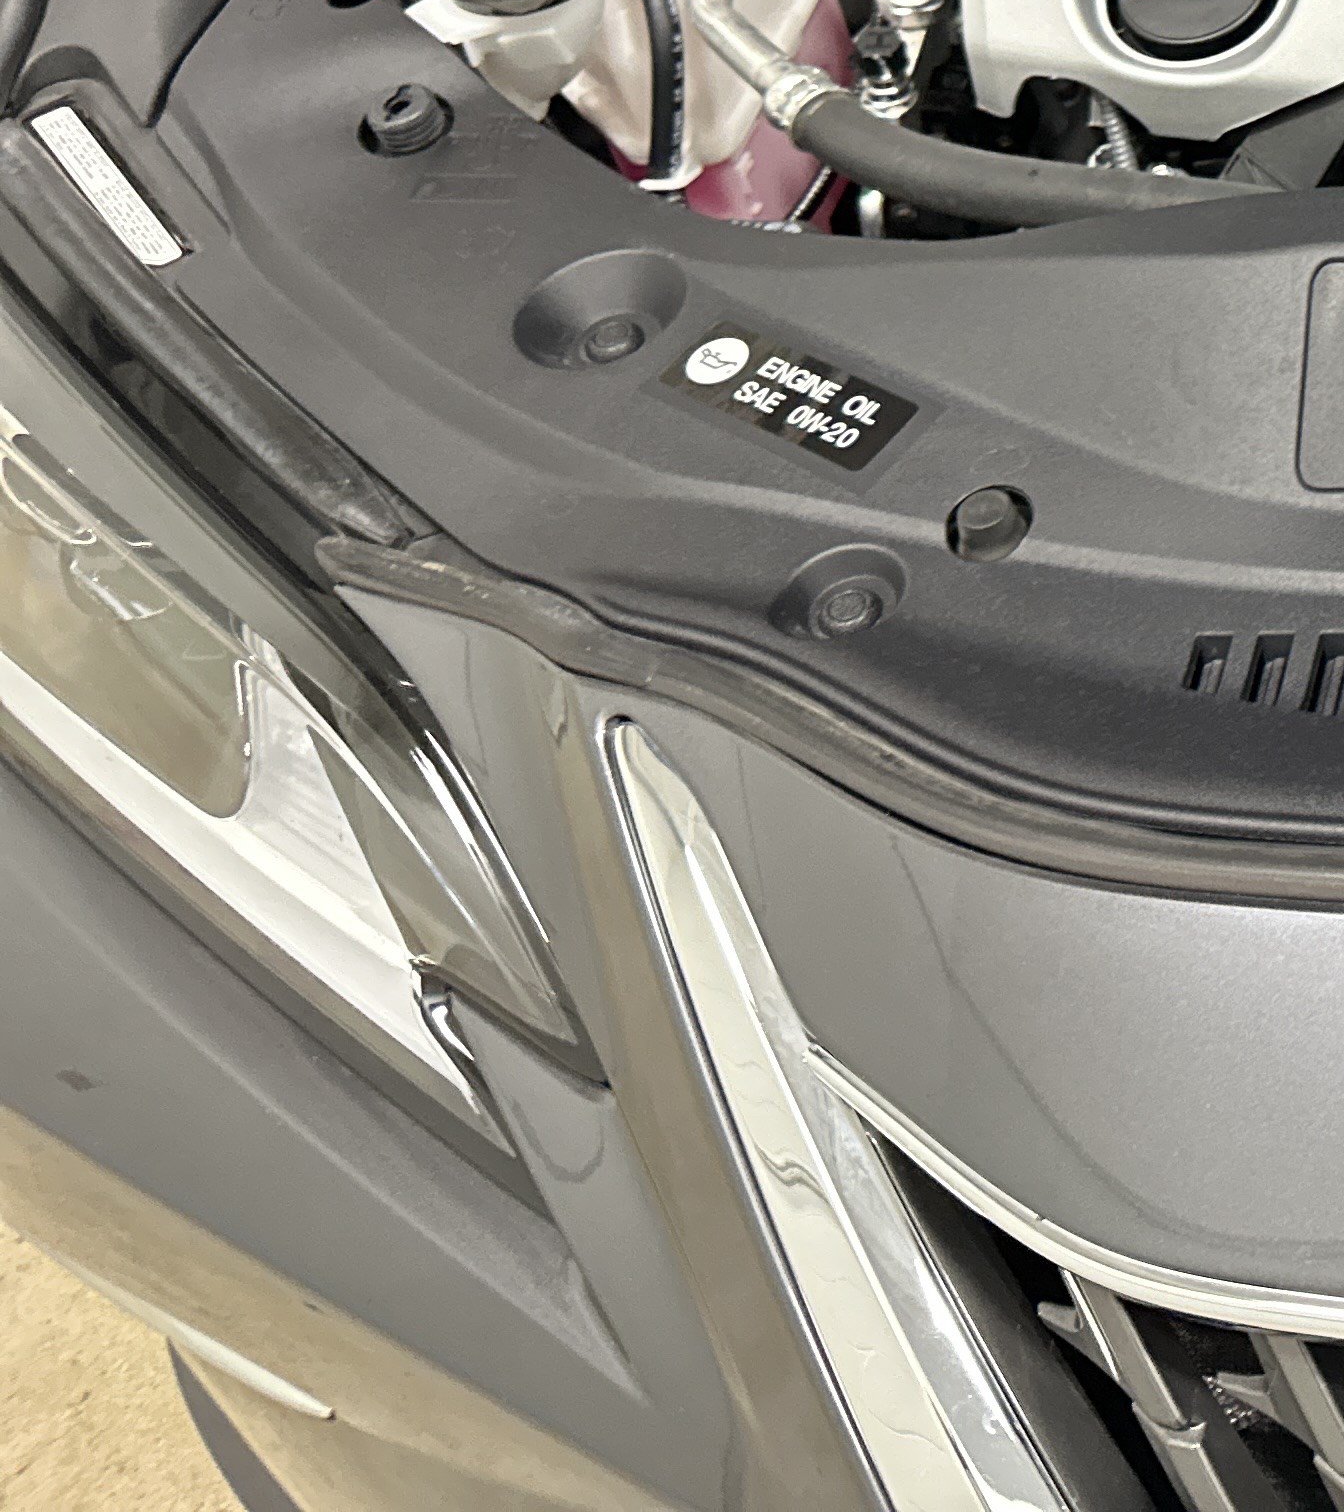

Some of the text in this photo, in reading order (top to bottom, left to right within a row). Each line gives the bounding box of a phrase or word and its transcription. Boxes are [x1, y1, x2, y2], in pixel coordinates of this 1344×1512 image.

[732, 380, 861, 449] SAE 0W-20
[756, 356, 882, 426] ENGINE OIL
